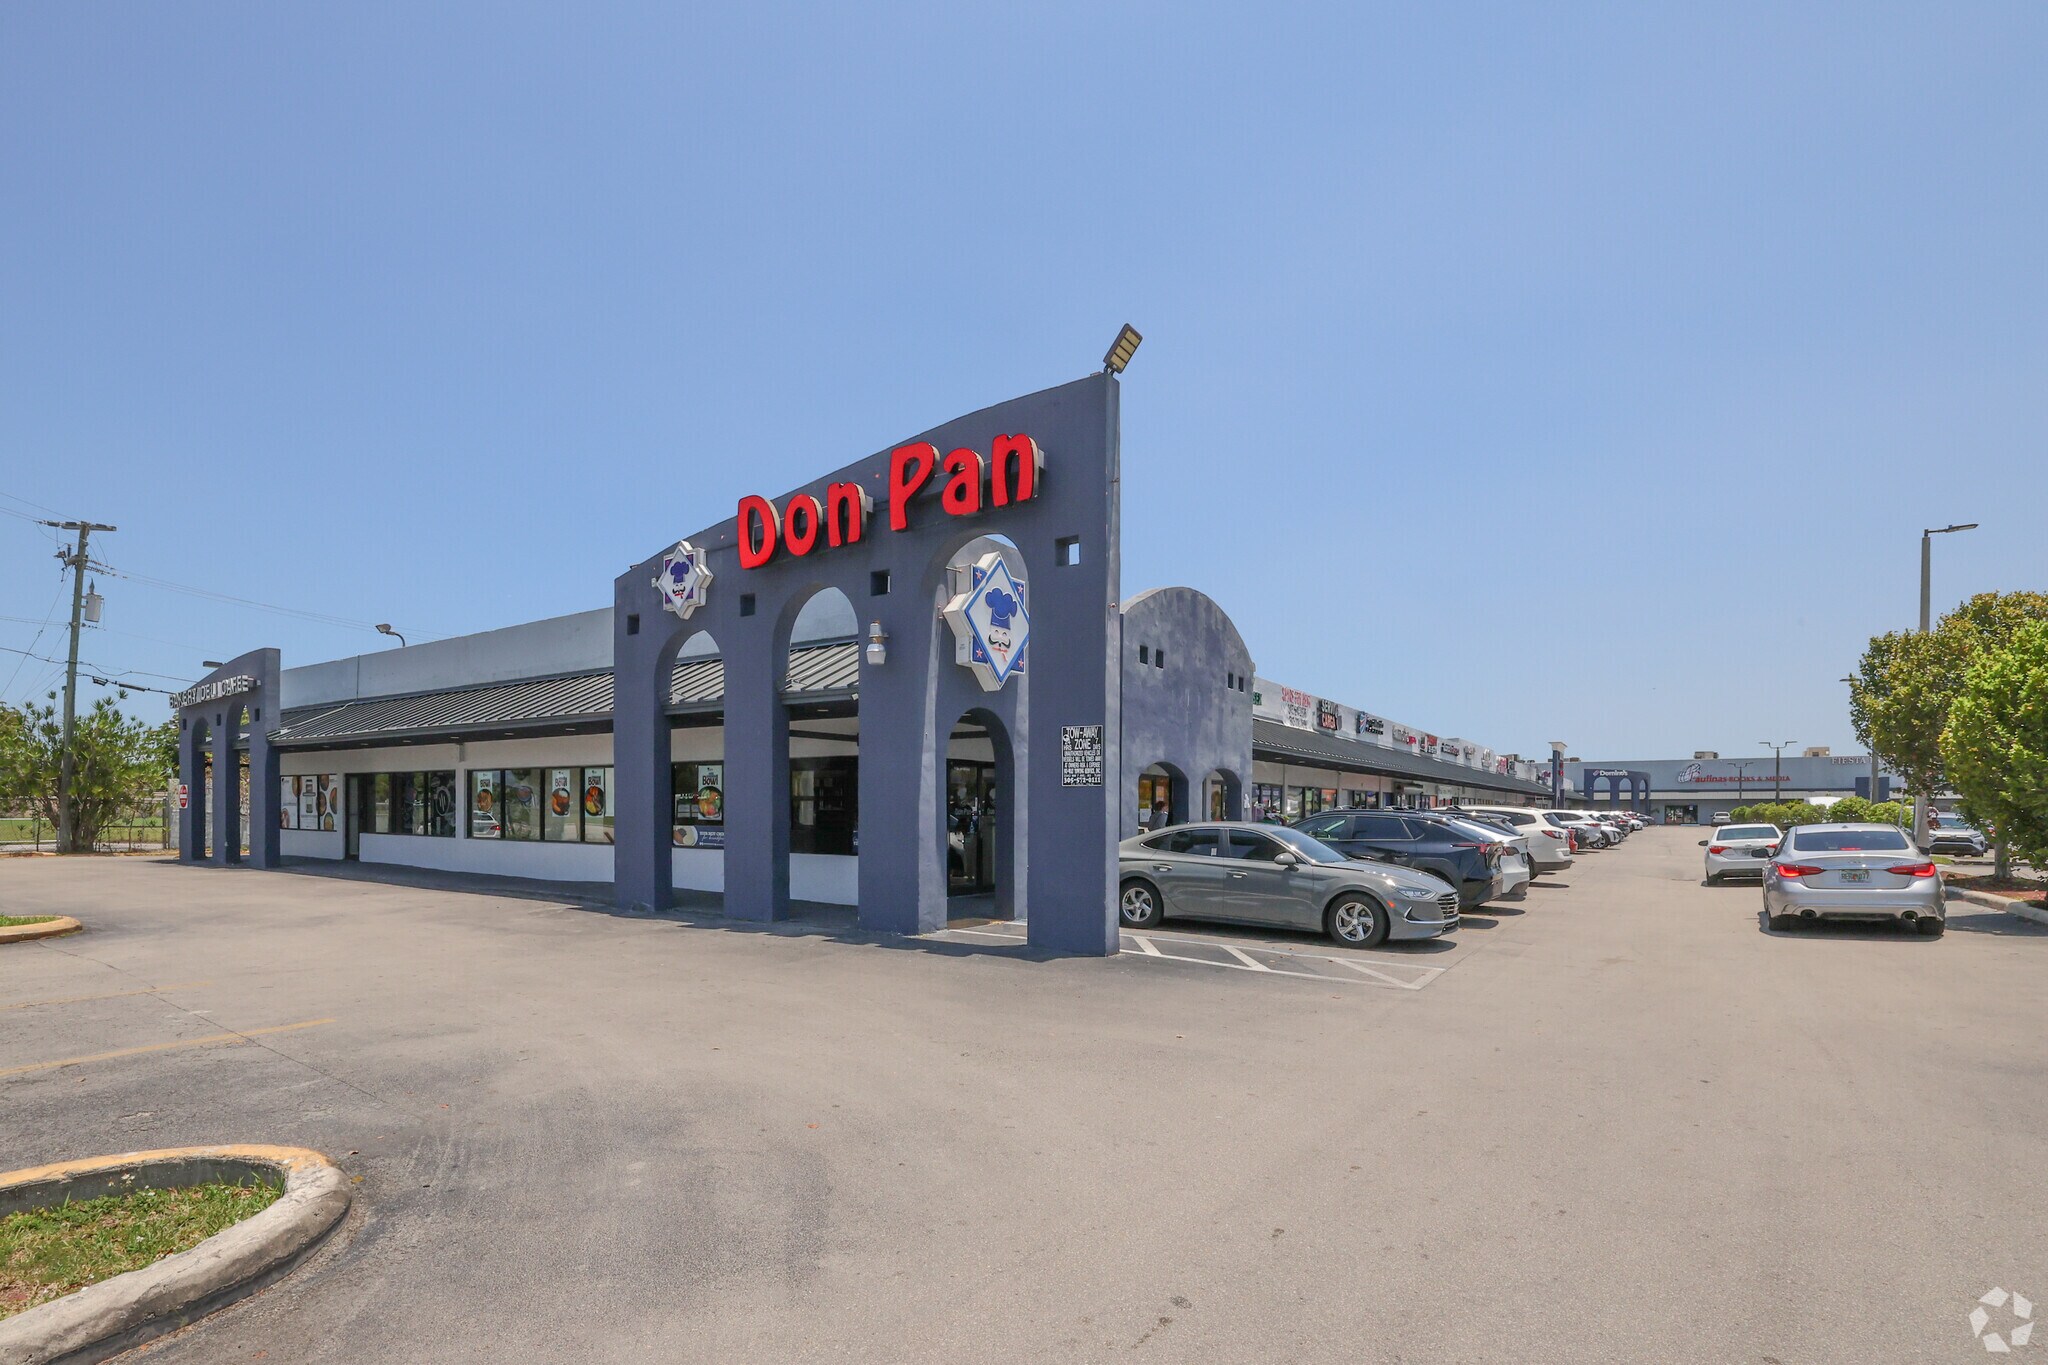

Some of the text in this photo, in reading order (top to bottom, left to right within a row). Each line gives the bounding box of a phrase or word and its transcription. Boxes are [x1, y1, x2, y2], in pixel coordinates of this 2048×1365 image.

[738, 433, 1044, 569] Don Pan
[1074, 738, 1091, 750] ZONE
[1831, 757, 1866, 765] FIESTA
[1600, 769, 1628, 777] Domino's
